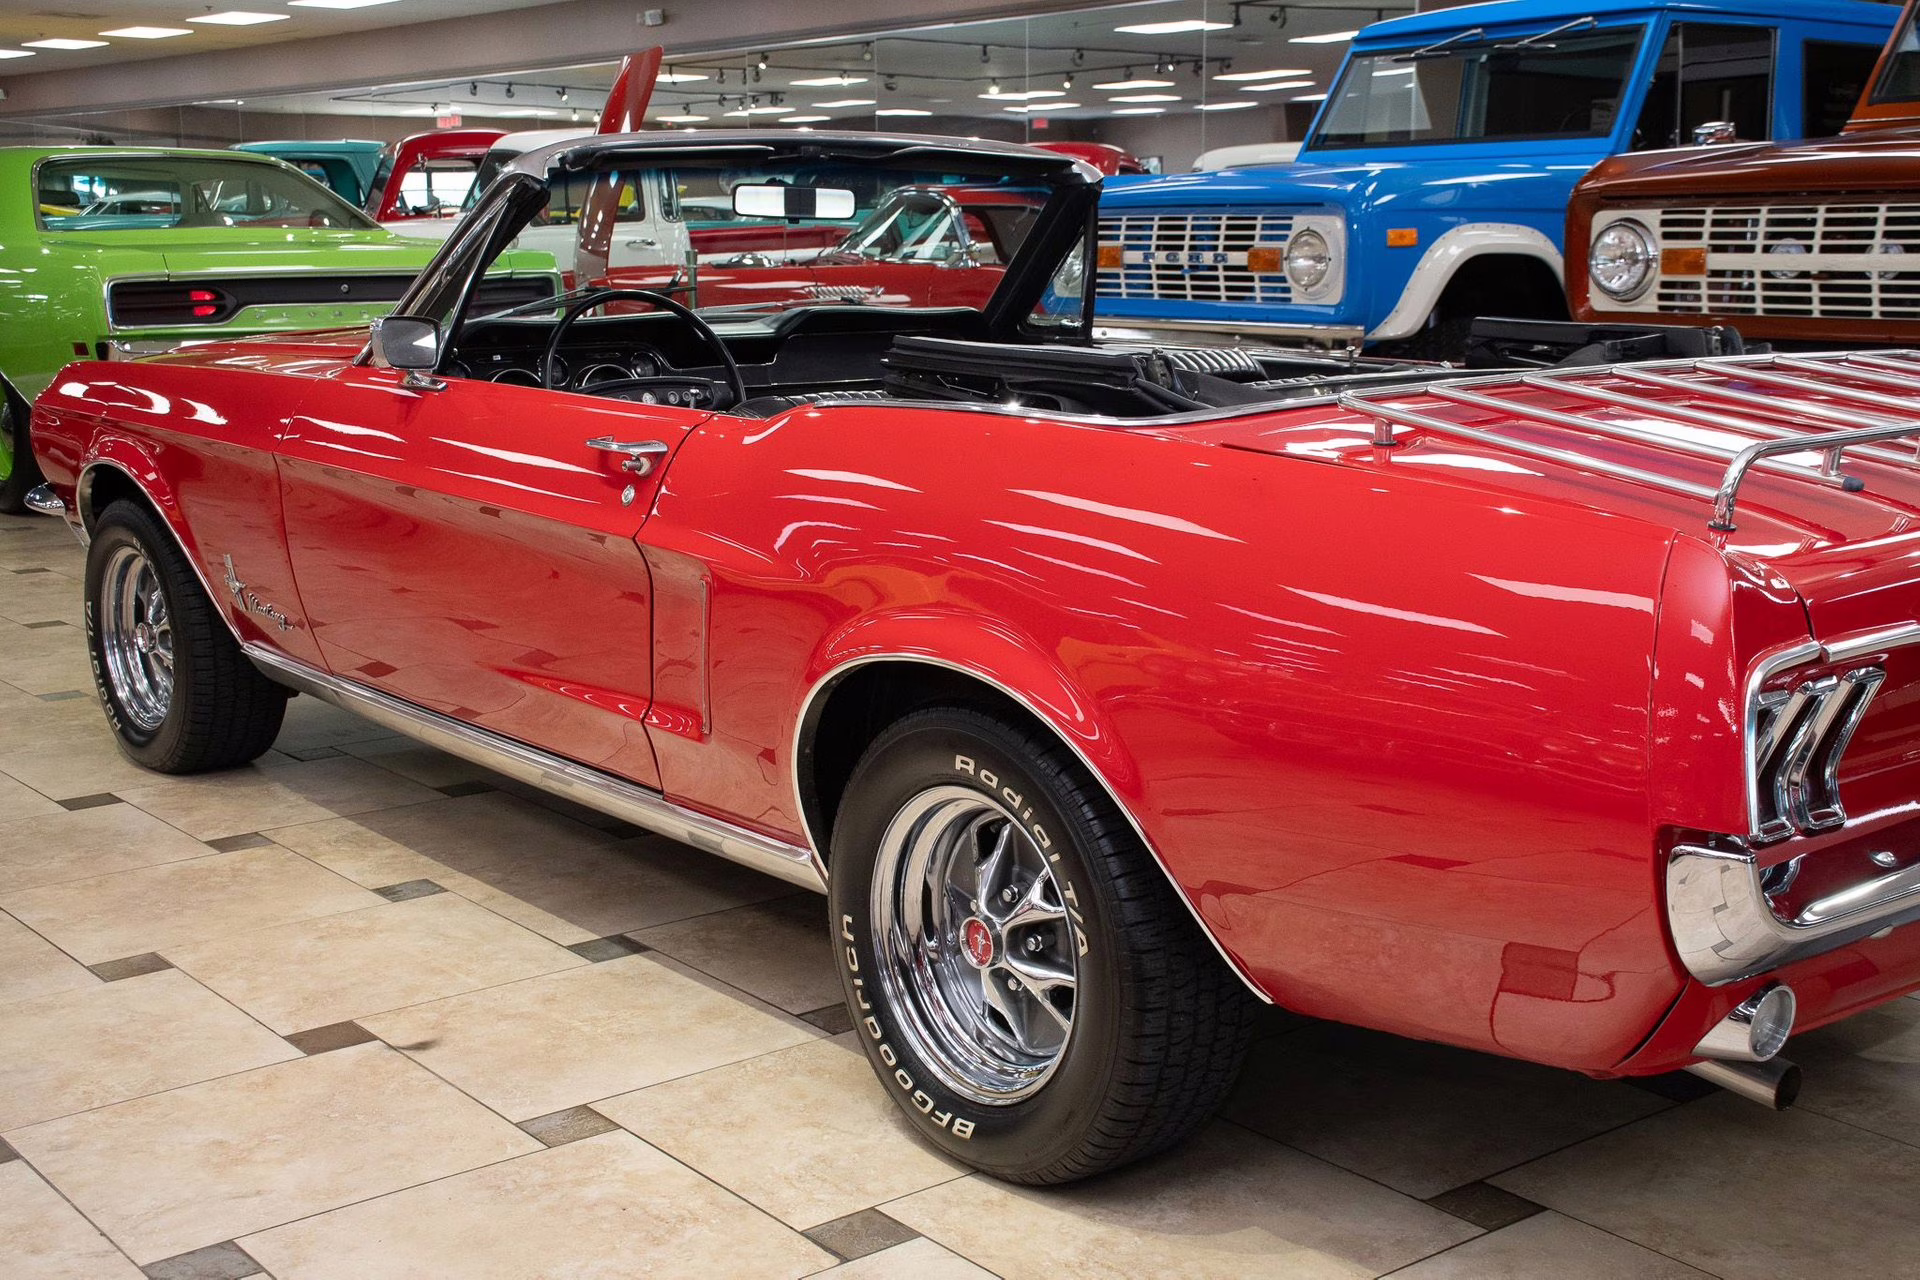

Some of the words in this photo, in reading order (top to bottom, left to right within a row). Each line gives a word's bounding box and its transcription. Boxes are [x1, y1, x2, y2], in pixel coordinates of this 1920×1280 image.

[248, 593, 294, 631] Mustang
[955, 754, 1062, 863] Radial
[1064, 881, 1089, 958] T/A
